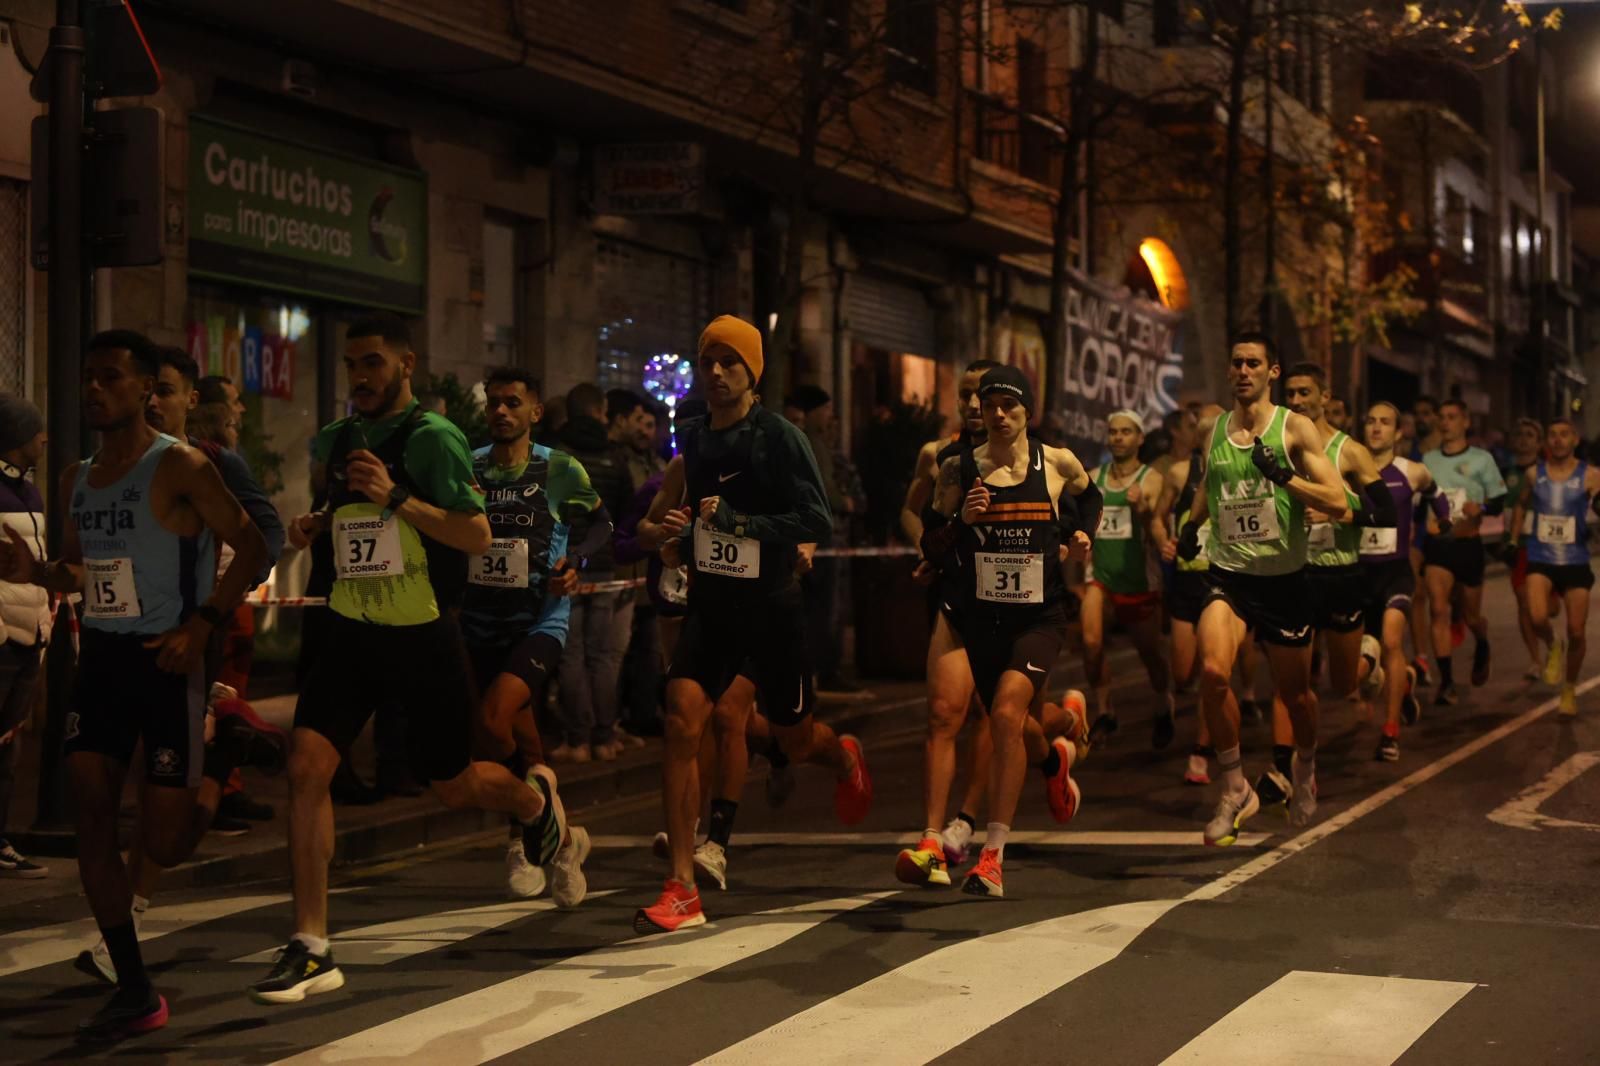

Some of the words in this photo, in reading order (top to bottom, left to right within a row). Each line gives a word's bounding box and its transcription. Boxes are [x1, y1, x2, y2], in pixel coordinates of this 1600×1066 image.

[204, 142, 352, 216] Cartuchos
[204, 213, 233, 233] para
[237, 202, 352, 257] impresoras
[192, 327, 292, 393] AHORRA
[348, 521, 384, 530] CORREO
[1102, 518, 1118, 531] 21
[1236, 514, 1260, 533] 16
[994, 528, 1032, 538] VICKY
[1368, 533, 1378, 544] 4
[491, 542, 515, 550] RREO
[999, 538, 1030, 546] FOODS
[349, 538, 377, 564] 37
[710, 540, 738, 564] 30
[482, 556, 509, 575] 34
[698, 560, 708, 568] EL
[709, 562, 745, 574] CORREO
[994, 557, 1031, 565] CORREO
[349, 564, 388, 573] CORREO
[482, 575, 515, 584] CORREO
[995, 571, 1020, 591] 31
[94, 582, 116, 604] 15
[985, 590, 994, 598] EL
